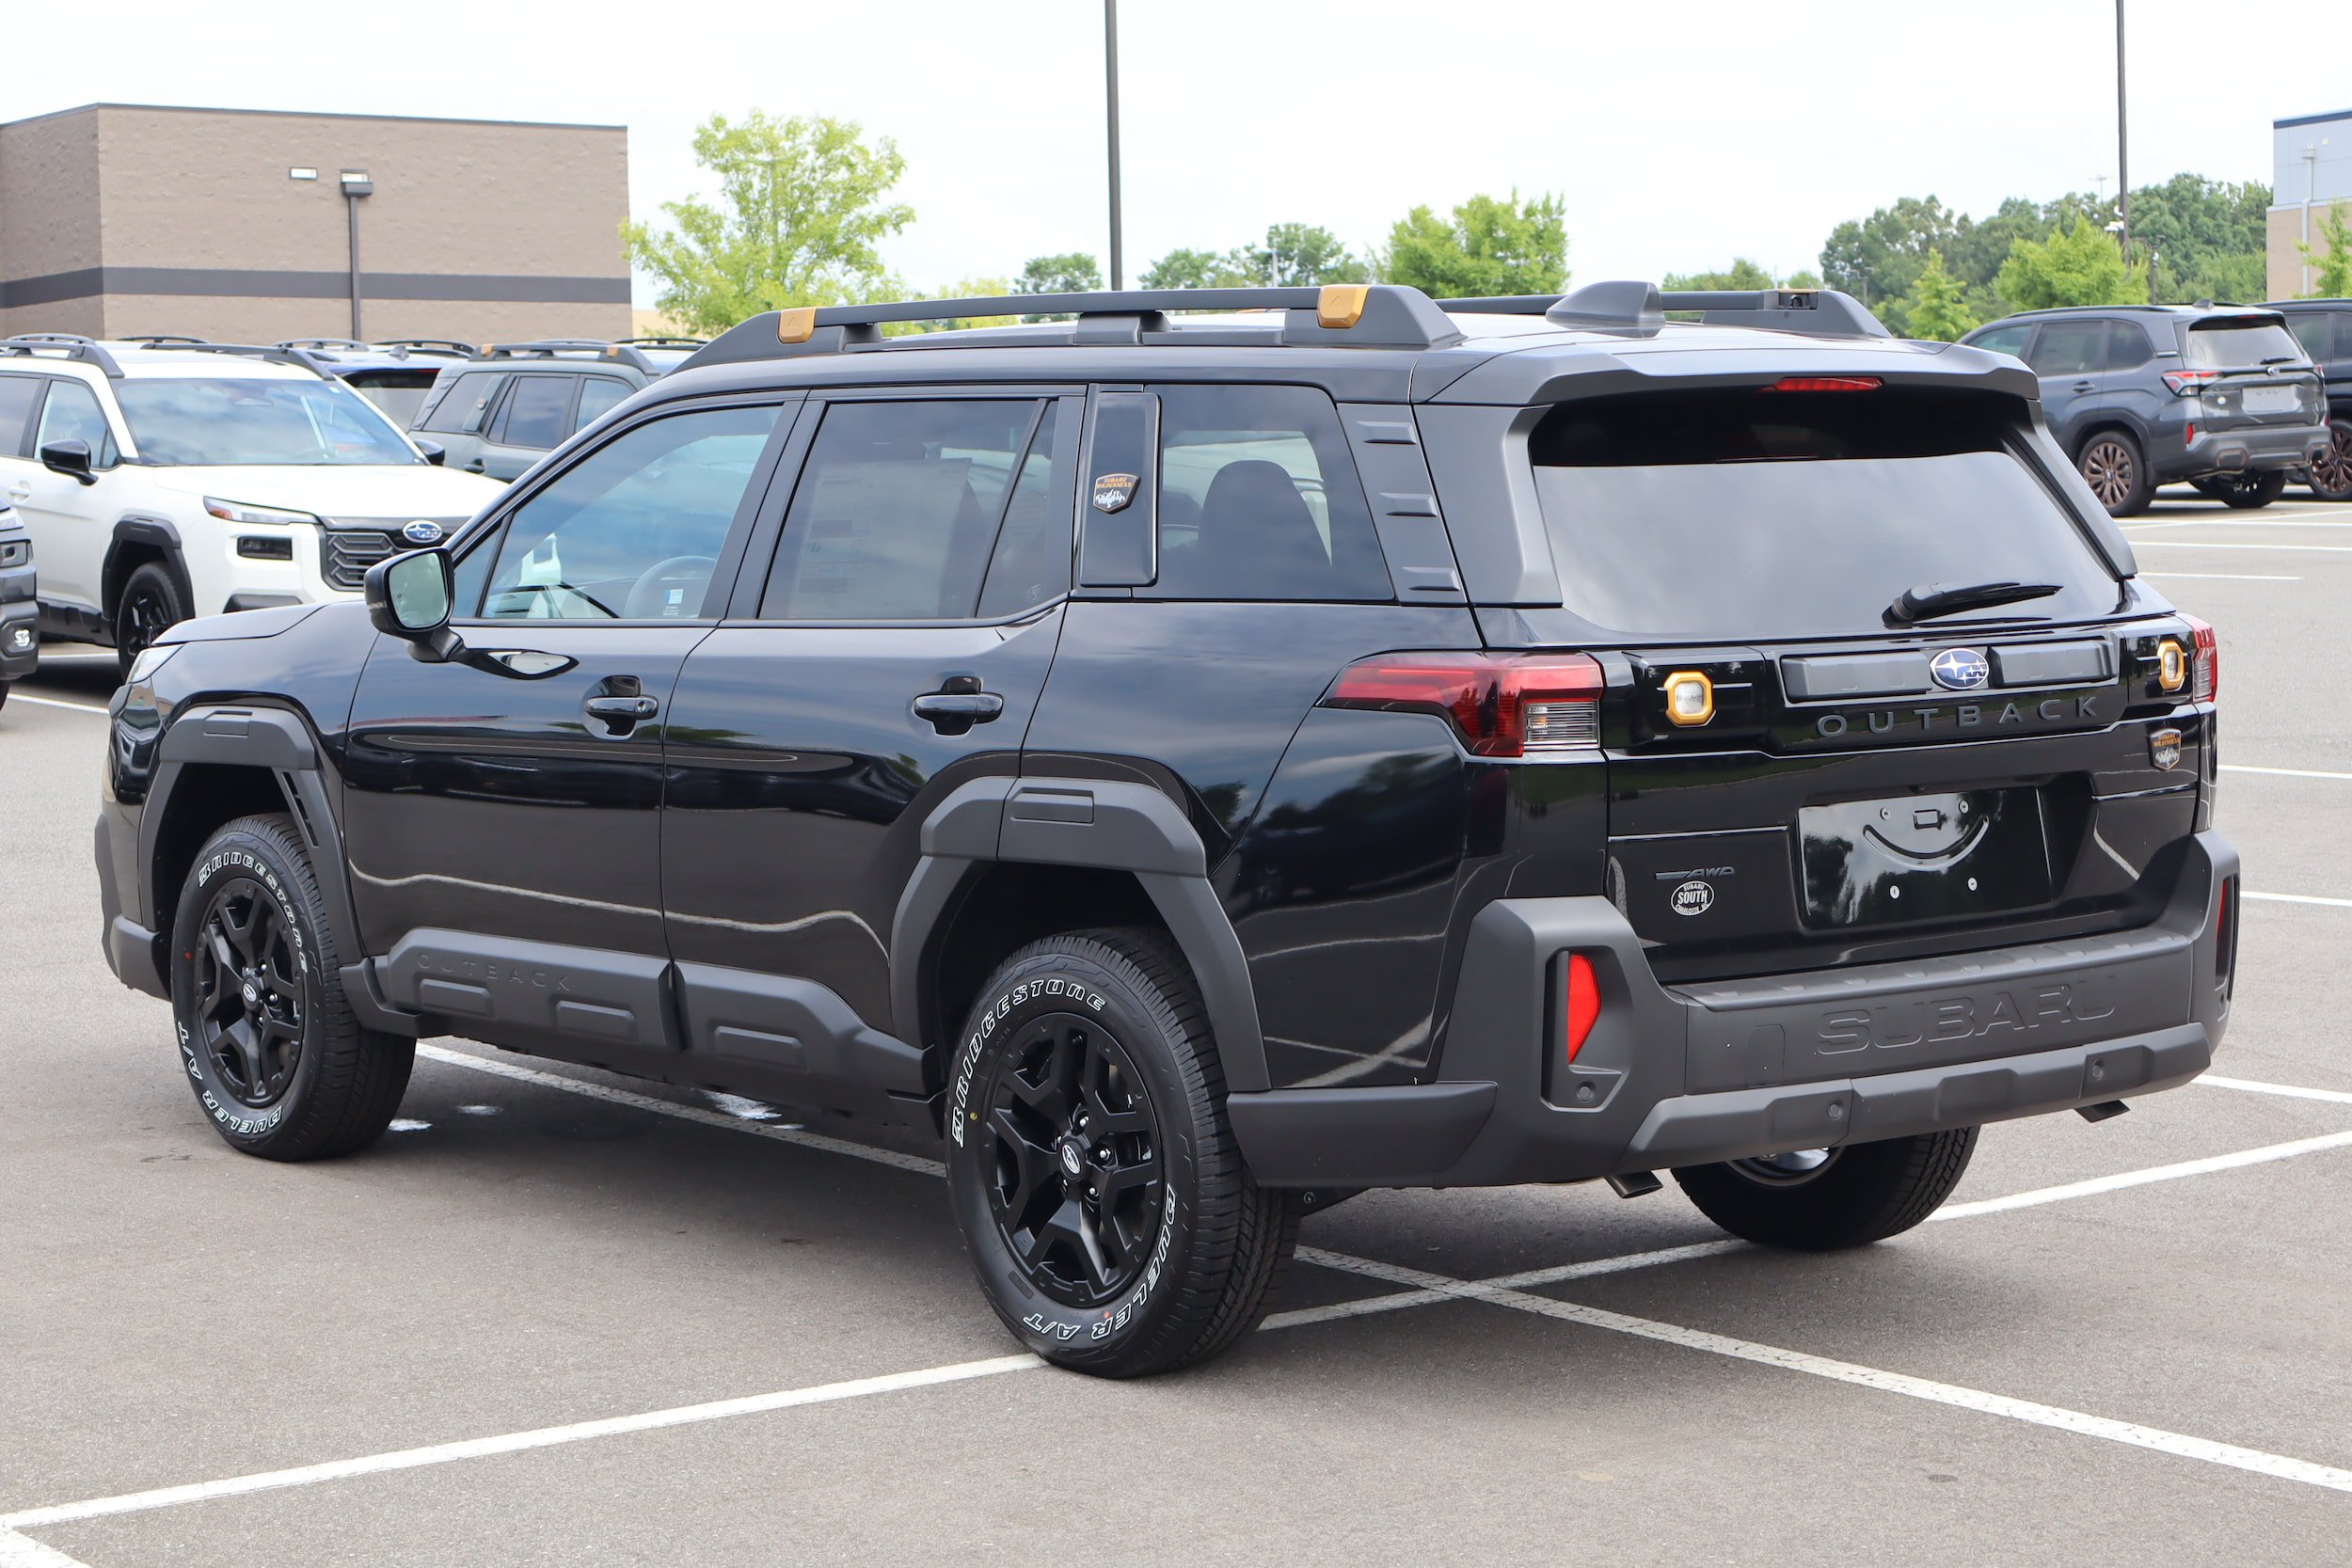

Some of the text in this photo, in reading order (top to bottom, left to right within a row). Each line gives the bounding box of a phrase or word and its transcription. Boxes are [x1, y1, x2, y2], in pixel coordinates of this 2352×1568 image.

[1818, 695, 2101, 738] OUTBACK
[1677, 890, 1708, 905] SOUTH
[1686, 866, 1736, 879] AWD
[199, 851, 308, 974] BRIDGESTONE
[417, 953, 571, 991] OUTBACK
[1817, 976, 2117, 1055] SUBARU
[176, 1021, 283, 1135] DUELER A/T
[951, 979, 1106, 1148] BRIDGESTONE
[1024, 1183, 1178, 1341] DUELER A/T
